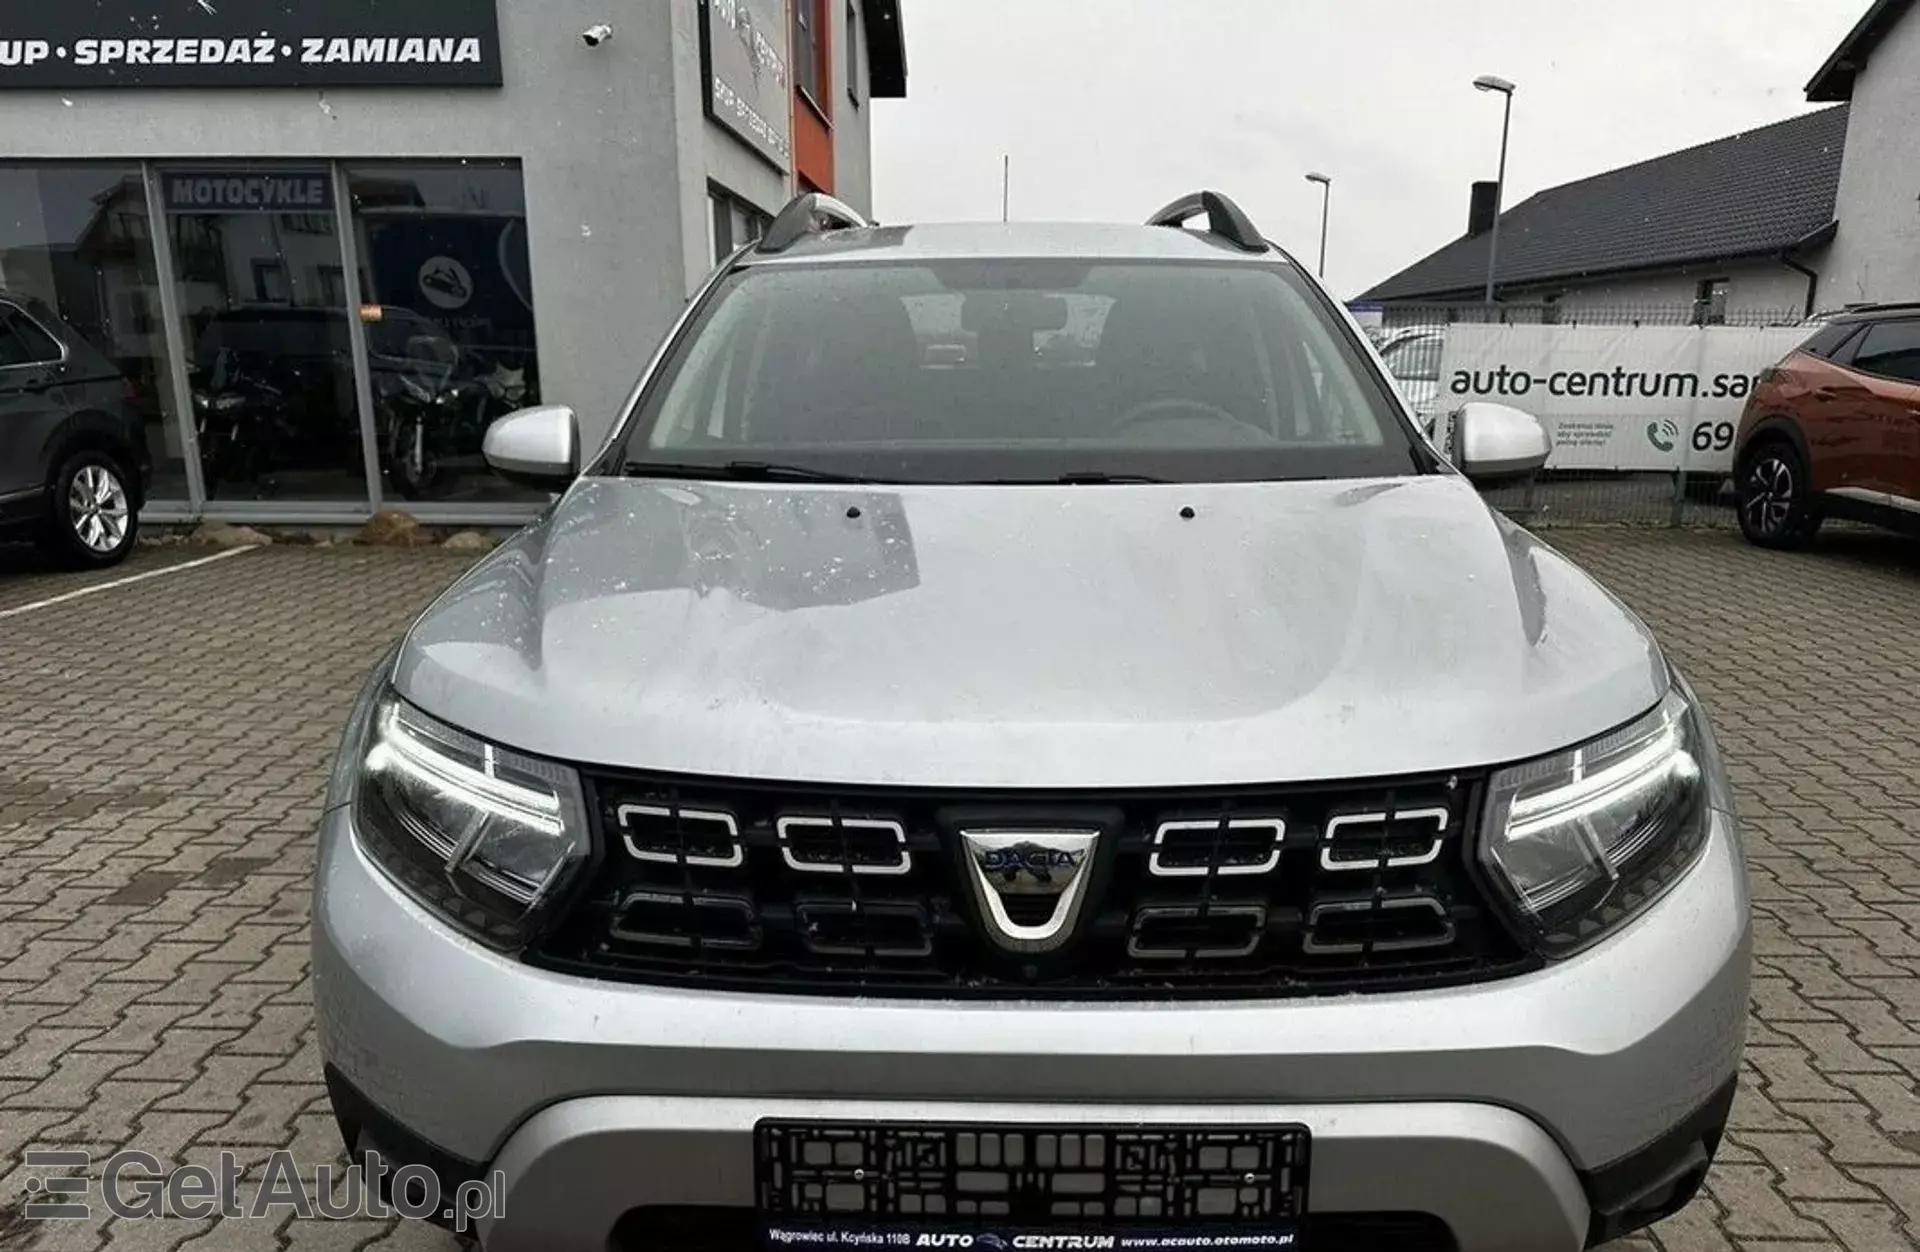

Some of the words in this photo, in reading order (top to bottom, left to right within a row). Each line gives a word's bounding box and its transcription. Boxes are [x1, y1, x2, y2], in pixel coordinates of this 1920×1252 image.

[74, 31, 276, 65] SPRZEDAŻ
[301, 37, 482, 63] ZAMIANA
[172, 177, 325, 206] MOTOCYKLE
[1691, 421, 1735, 452] 69
[985, 850, 1076, 870] DACIA
[769, 1228, 825, 1244] Wągrowiec
[826, 1230, 839, 1243] ul.
[841, 1231, 884, 1246] Kcyńska
[886, 1233, 911, 1245] 110B
[915, 1233, 974, 1248] AUTO
[1012, 1235, 1115, 1249] CENTRUM
[1121, 1233, 1295, 1247] www.acauto.otomoto.pl
